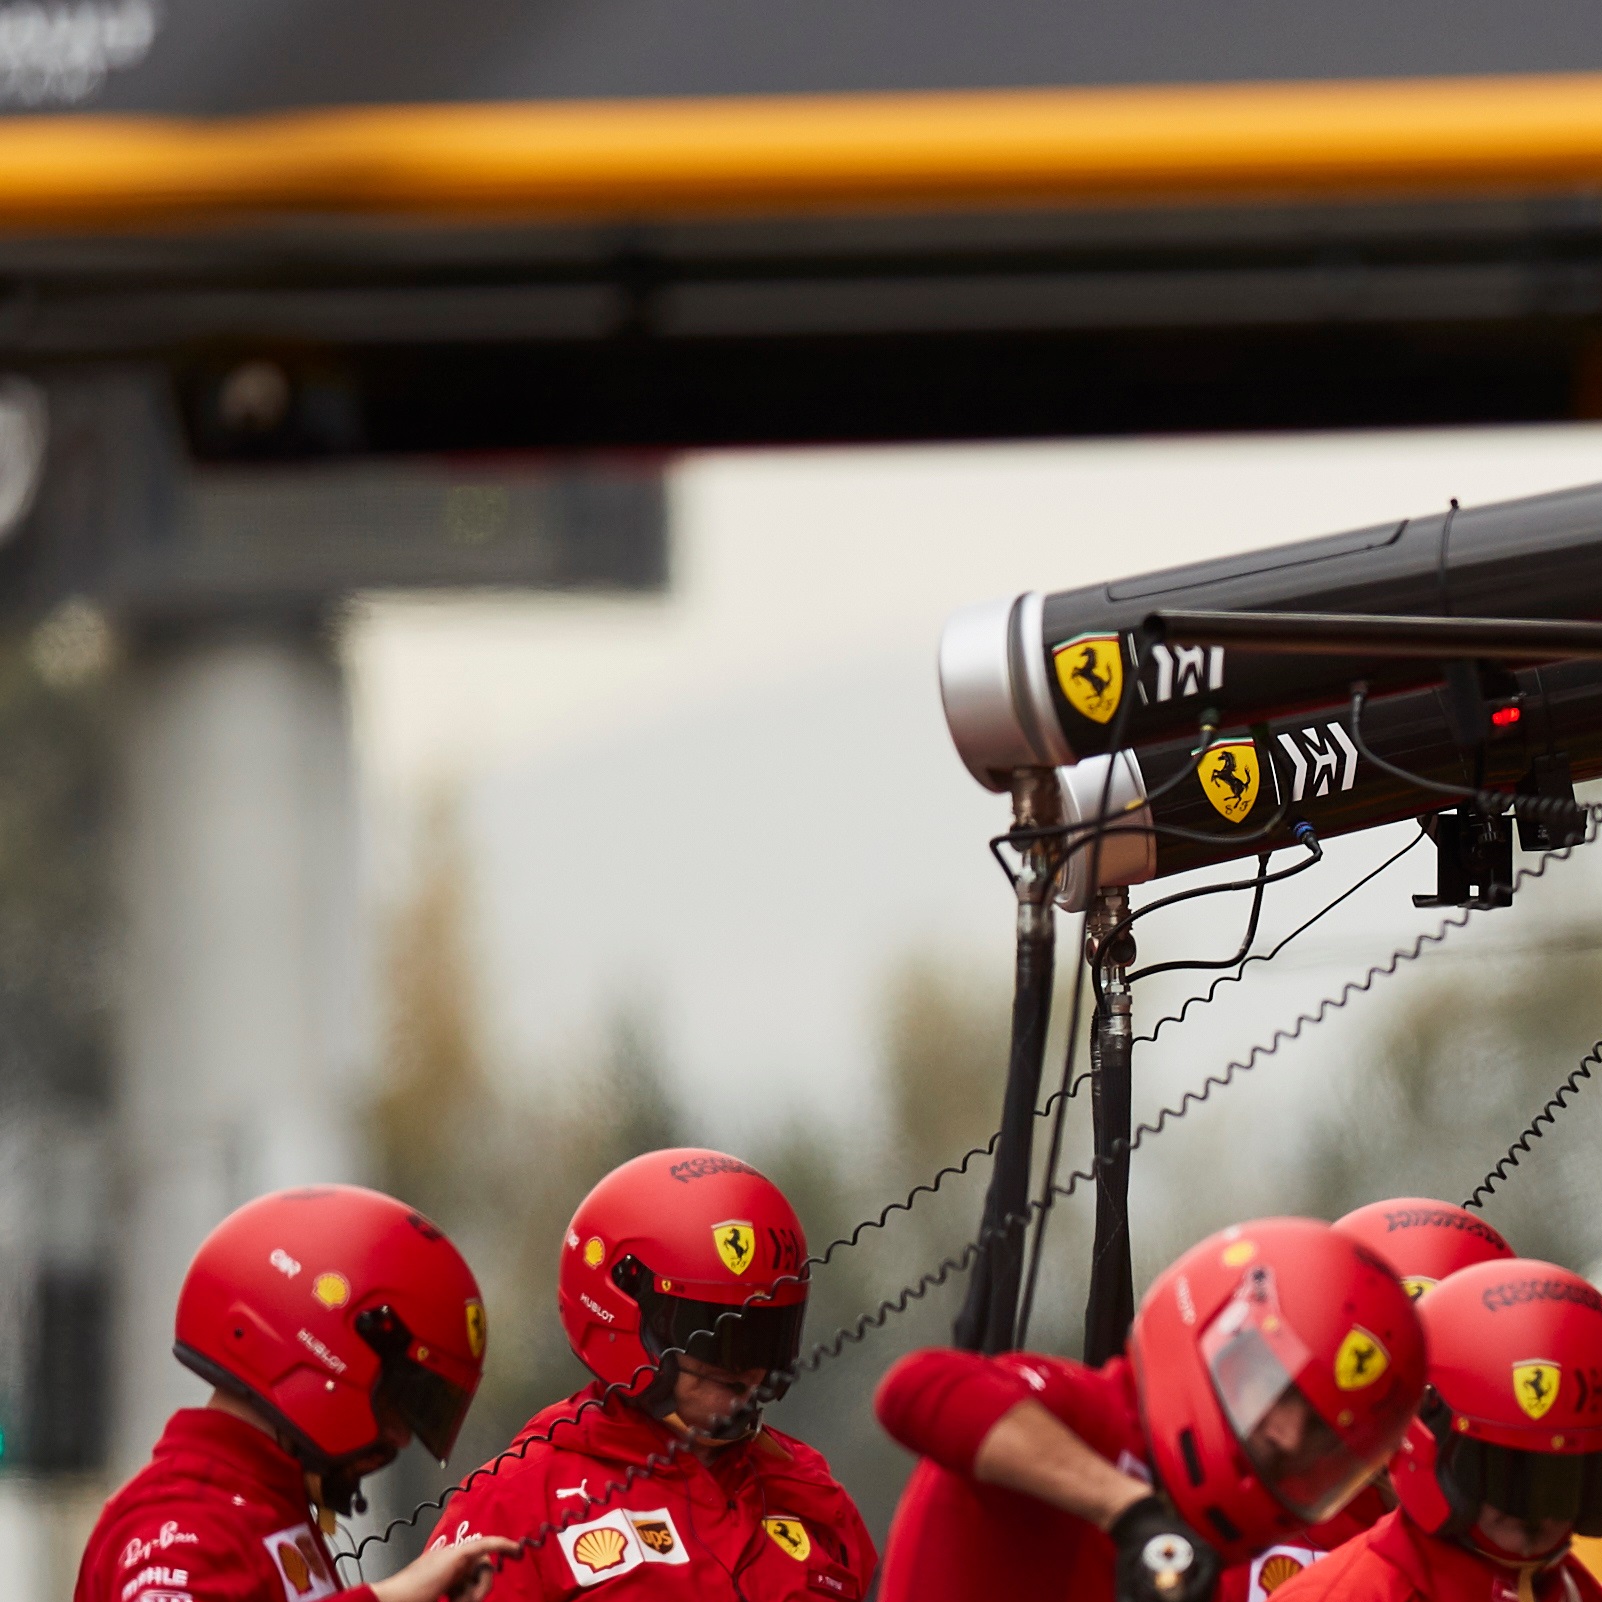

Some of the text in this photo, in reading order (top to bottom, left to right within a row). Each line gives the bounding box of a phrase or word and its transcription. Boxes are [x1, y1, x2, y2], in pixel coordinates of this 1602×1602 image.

[579, 1293, 615, 1324] HUBLOT
[297, 1327, 347, 1375] HUBLOT
[643, 1525, 674, 1555] ups
